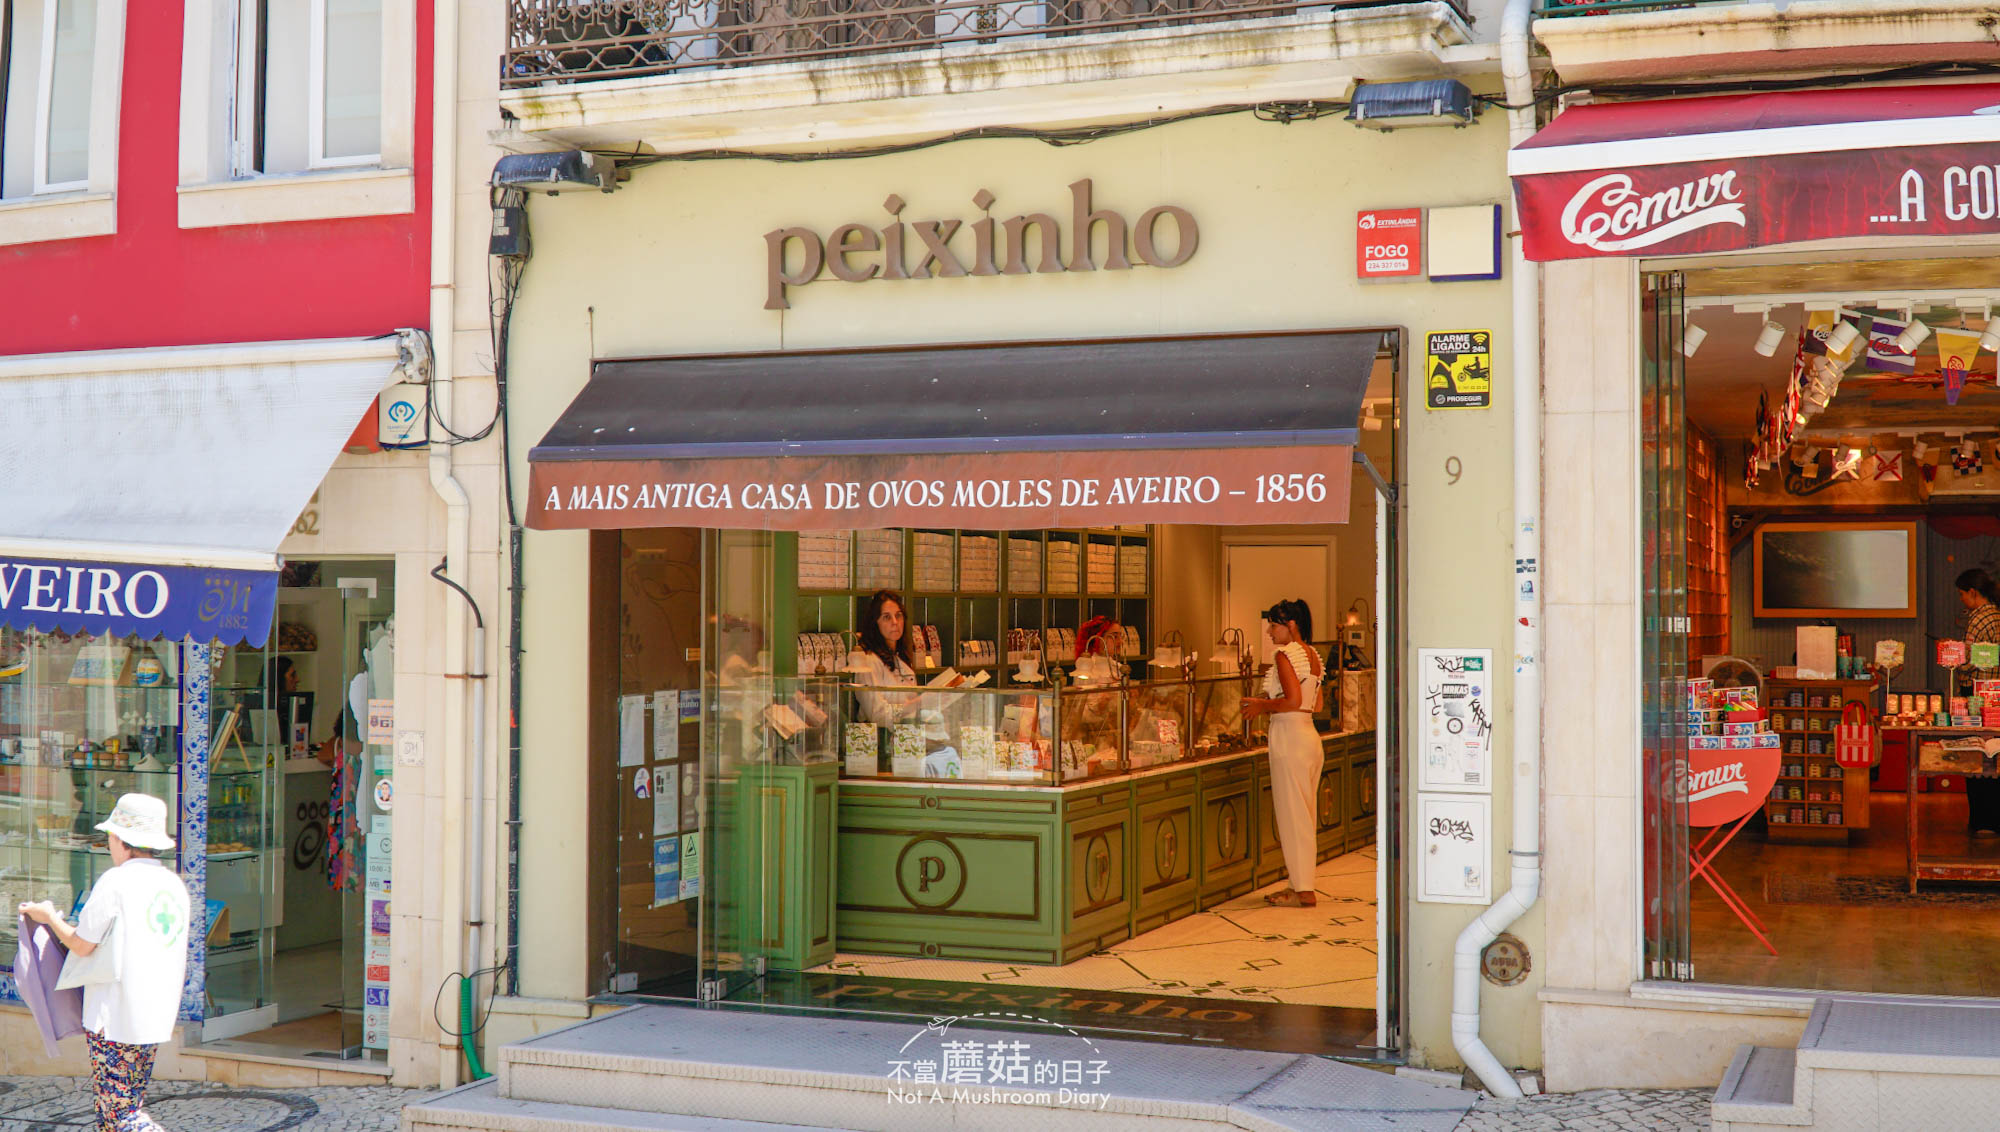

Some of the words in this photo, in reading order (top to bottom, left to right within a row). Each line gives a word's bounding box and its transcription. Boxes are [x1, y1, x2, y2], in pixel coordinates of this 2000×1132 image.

[1943, 164, 2000, 221] CO
[1560, 169, 1746, 252] Comur
[763, 178, 1200, 310] peixinho
[1365, 244, 1409, 258] FOGO
[1431, 334, 1470, 343] ALARME
[1431, 342, 1471, 351] LIGADO
[1472, 345, 1487, 353] 24h
[1445, 456, 1463, 486] 9
[544, 486, 561, 511] A
[567, 484, 630, 511] MAIS
[632, 483, 733, 509] ANTIGA
[741, 483, 813, 509] CASA
[824, 482, 861, 510] DE
[868, 479, 945, 508] OVOS
[951, 479, 1053, 508] MOLES
[1059, 479, 1099, 507] DE
[1106, 475, 1220, 505] AVEIRO
[1255, 473, 1327, 503] 1856
[219, 614, 248, 630] 1882
[811, 982, 1254, 1024] peixinho
